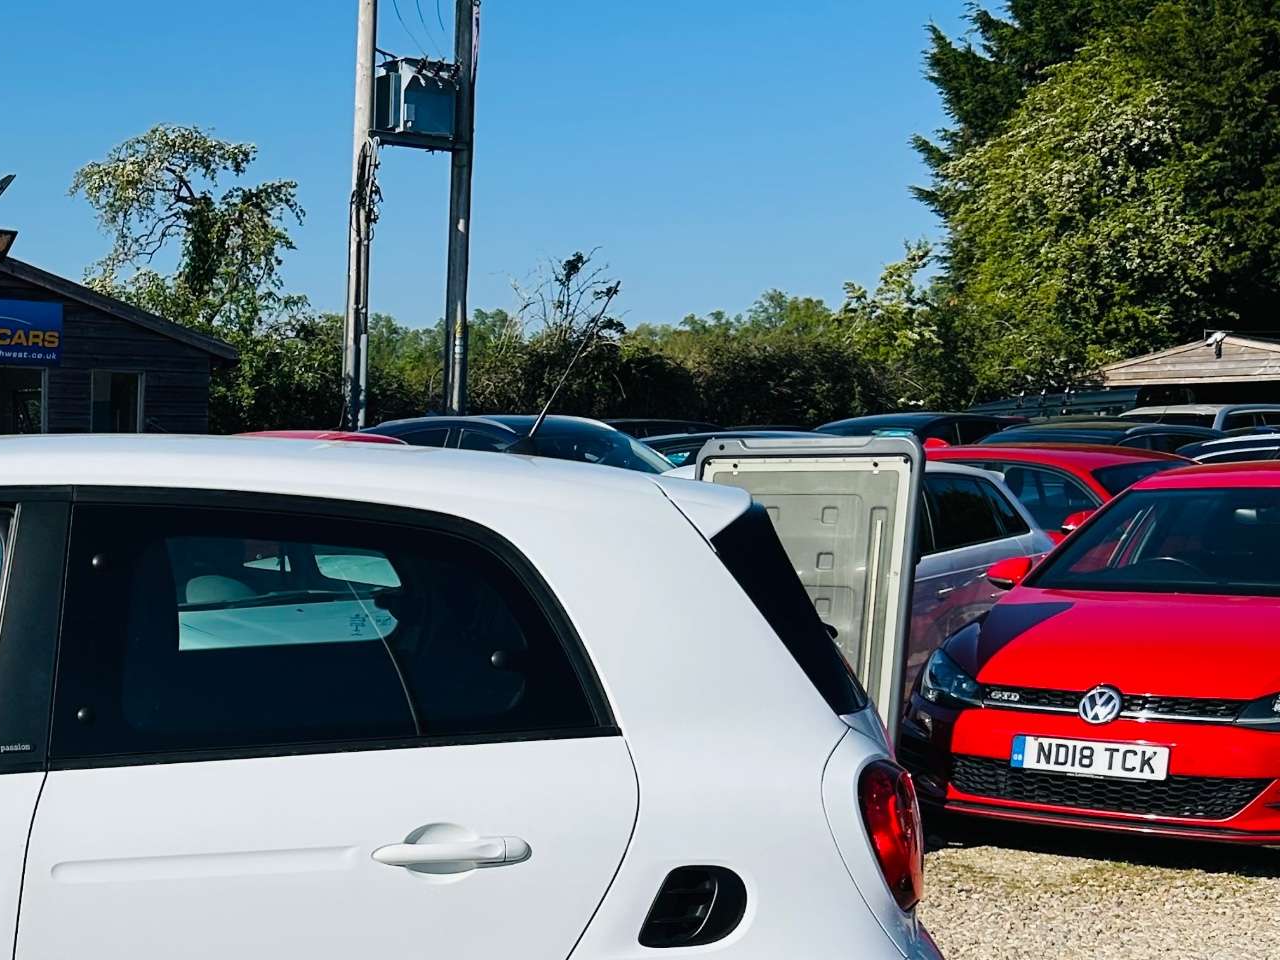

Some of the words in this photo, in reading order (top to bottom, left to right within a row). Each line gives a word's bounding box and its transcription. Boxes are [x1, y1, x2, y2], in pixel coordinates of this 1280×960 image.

[991, 691, 1020, 701] GTD
[0, 743, 31, 753] passion
[1036, 741, 1095, 769] ND18
[1104, 747, 1158, 775] TCK
